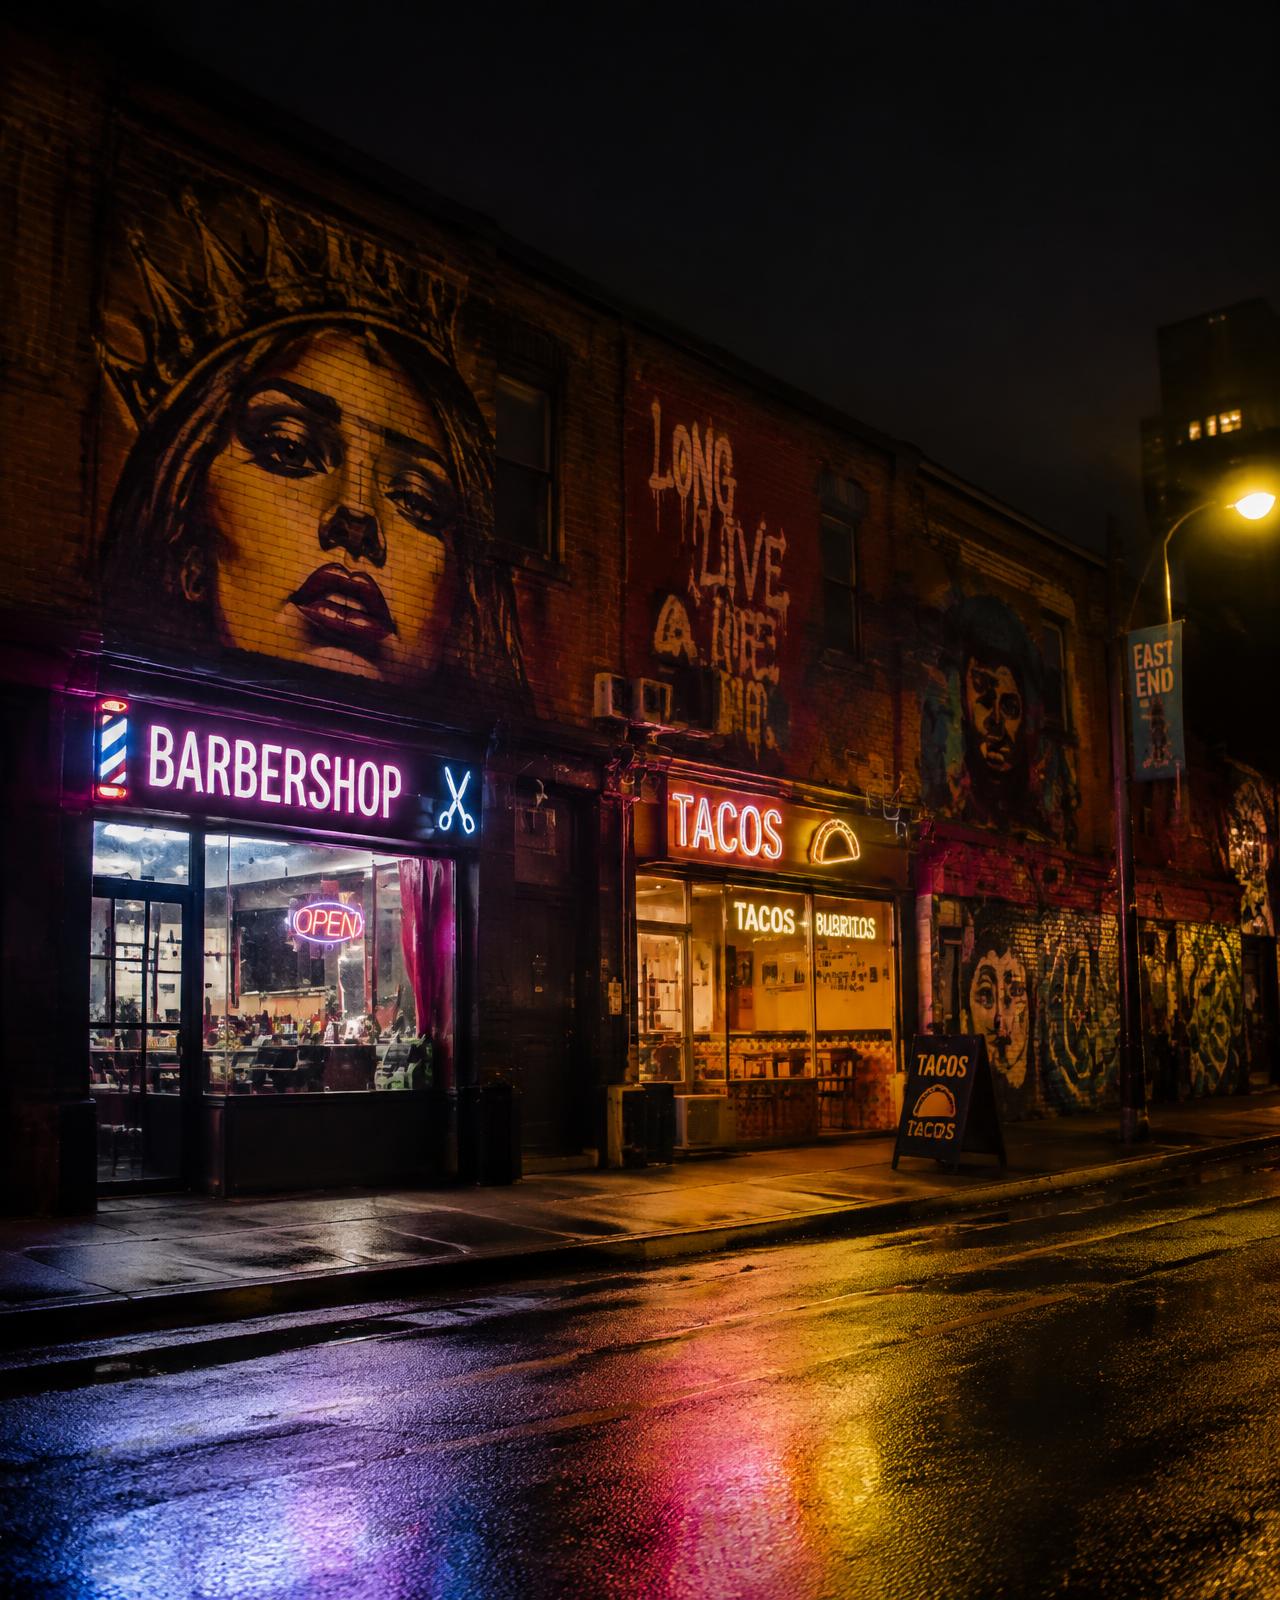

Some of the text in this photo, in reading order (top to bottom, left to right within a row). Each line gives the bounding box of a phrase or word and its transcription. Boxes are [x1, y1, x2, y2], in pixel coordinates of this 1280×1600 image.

[649, 400, 738, 516] LONG
[700, 514, 790, 610] LIVE
[1133, 639, 1174, 671] EAST
[1136, 667, 1174, 698] END
[148, 725, 402, 819] BARBERSHOP
[672, 793, 783, 860] TACOS
[295, 907, 361, 939] OPEN
[733, 901, 796, 935] TACOS
[917, 1053, 969, 1079] TACOS
